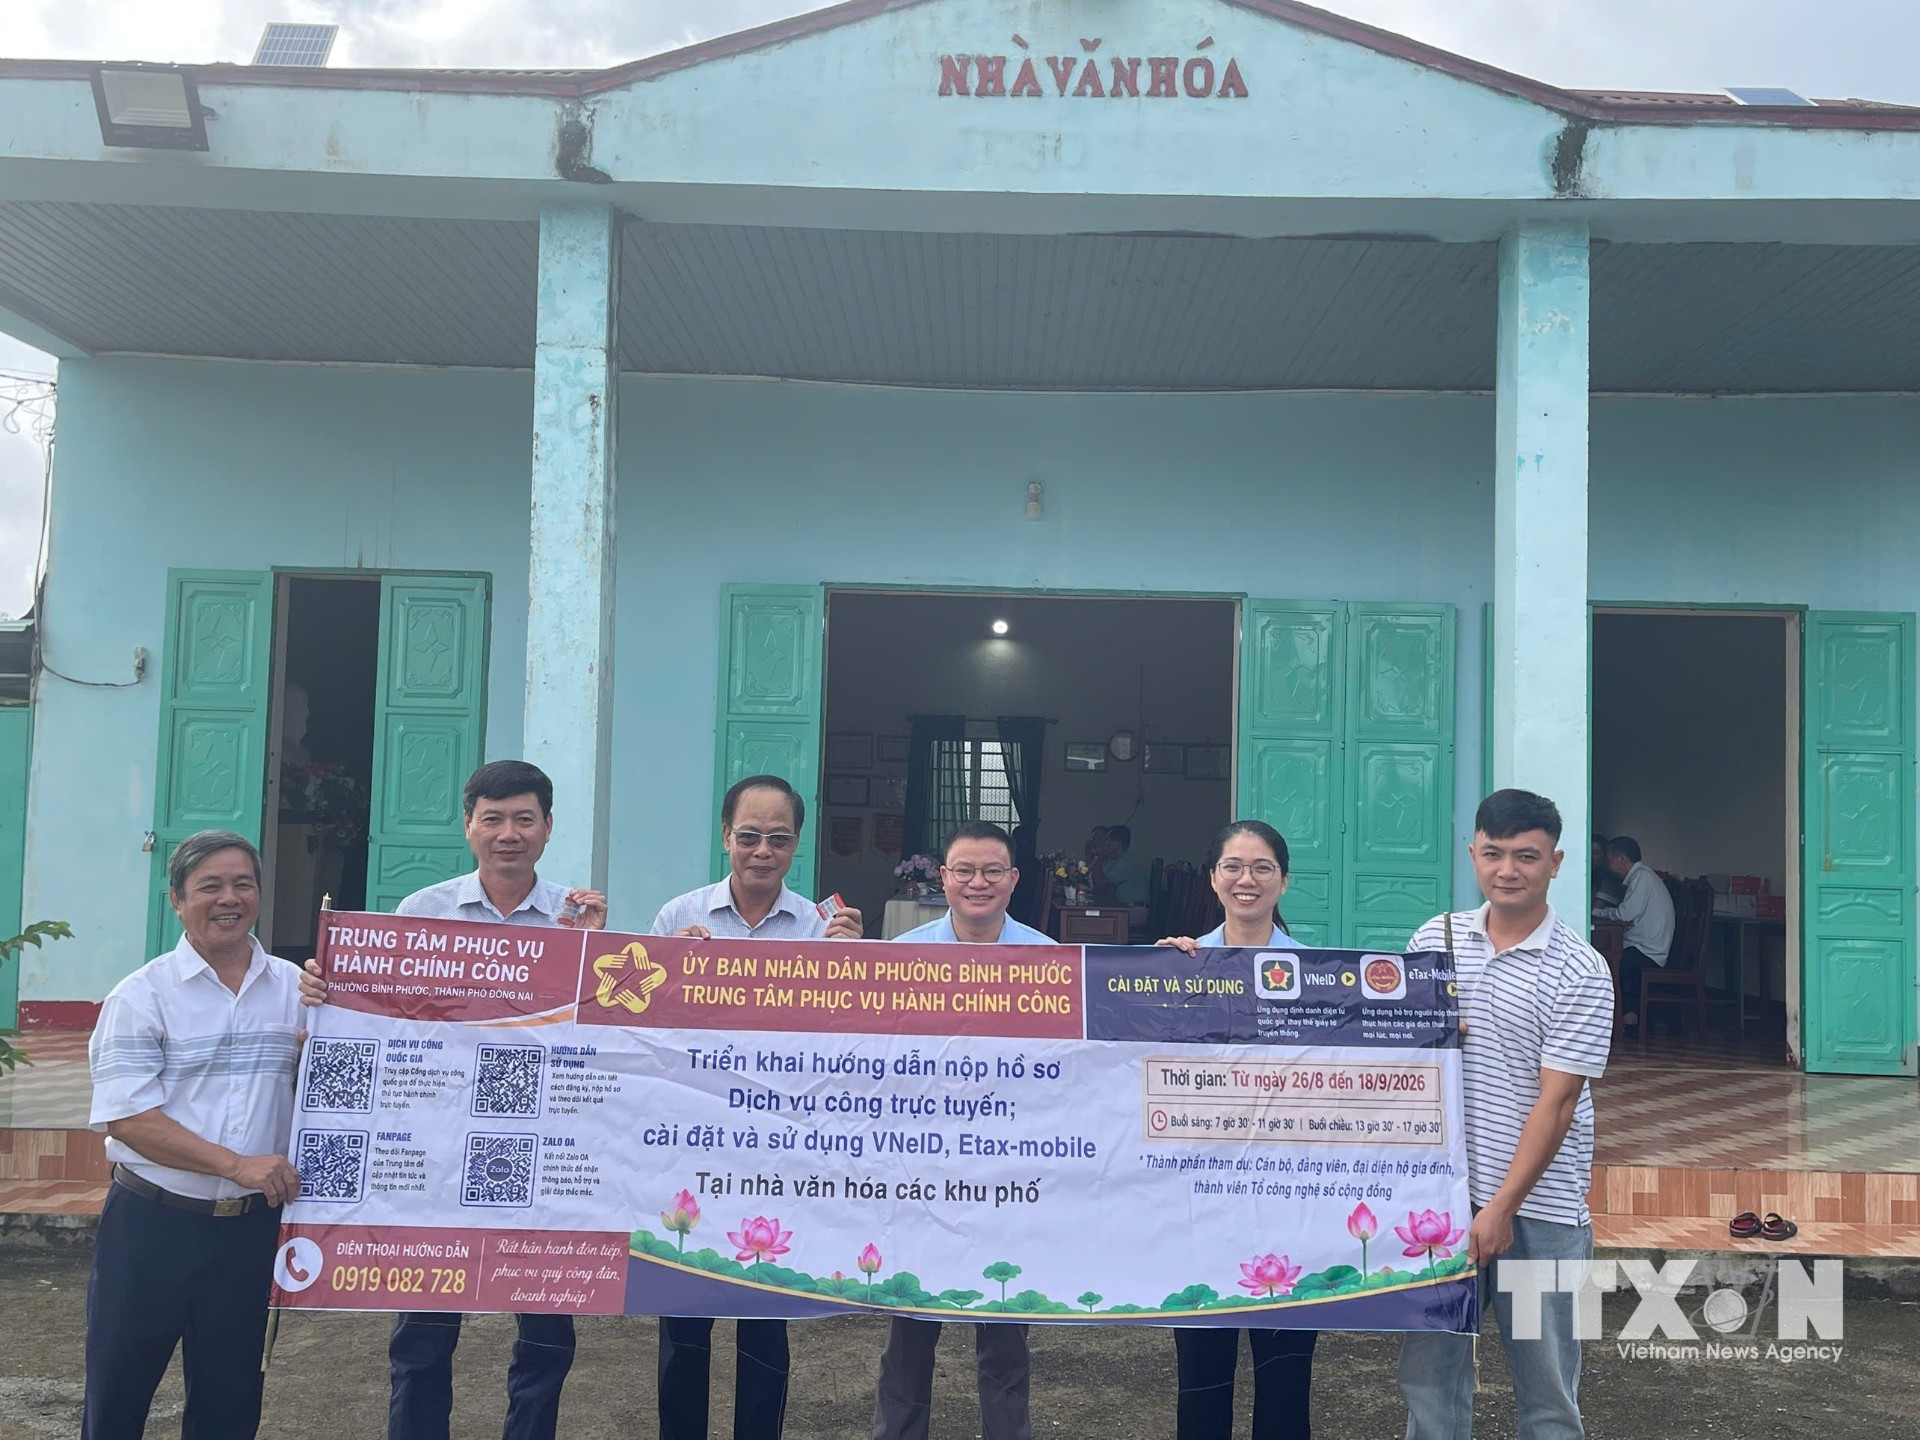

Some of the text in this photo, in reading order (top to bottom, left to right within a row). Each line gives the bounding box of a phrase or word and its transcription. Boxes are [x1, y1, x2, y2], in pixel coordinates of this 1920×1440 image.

[328, 926, 545, 963] TRUNG TÂM PHỤC VỤ
[333, 951, 529, 983] HÀNH CHÍNH CÔNG
[682, 951, 1072, 985] ỦY BAN NHÂN DÂN PHƯỜNG BÌNH PHƯỚC
[1108, 973, 1244, 997] CÀI ĐẶT VÀ SỬ DỤNG
[1304, 973, 1336, 986] VNeID
[518, 992, 534, 1000] NAI
[682, 984, 1071, 1015] TRUNG TÂM PHỤC VỤ HÀNH CHÍNH CÔNG
[388, 1038, 443, 1050] DỊCH VỤ CÔNG
[687, 1045, 1061, 1082] Triển khai hướng dẫn nộp hồ sơ
[1161, 1068, 1425, 1092] Thời gian: Từ ngày 26/8 đến 18/9/2026
[729, 1088, 1016, 1121] Dịch vụ công trực tuyến;
[1215, 1117, 1220, 1128] 7
[1258, 1118, 1266, 1129] 11
[1355, 1120, 1365, 1131] 13
[1402, 1121, 1412, 1132] 17
[377, 1131, 412, 1141] FANPAGE
[542, 1137, 575, 1146] ZALO OA
[643, 1123, 1097, 1159] cài đặt và sử dụng VNeID, Etax-mobile
[490, 1165, 509, 1173] Zalo
[1146, 1154, 1177, 1169] Thành
[1180, 1154, 1206, 1172] phần
[1208, 1157, 1233, 1170] tham
[1255, 1156, 1275, 1171] Cán
[1278, 1157, 1294, 1173] bộ,
[1297, 1157, 1322, 1175] đảng
[1353, 1160, 1368, 1175] đại
[1371, 1160, 1393, 1175] diện
[1396, 1160, 1409, 1176] hộ
[1411, 1162, 1427, 1177] gia
[695, 1172, 1042, 1208] Tại nhà văn hóa các khu phố
[1194, 1178, 1392, 1200] thành viên Tổ công nghệ số cộng đồng
[337, 1240, 469, 1259] ĐIỆN THOẠI HƯỚNG DẪN
[332, 1266, 466, 1294] 0919 082 728
[510, 1287, 546, 1302] doanh
